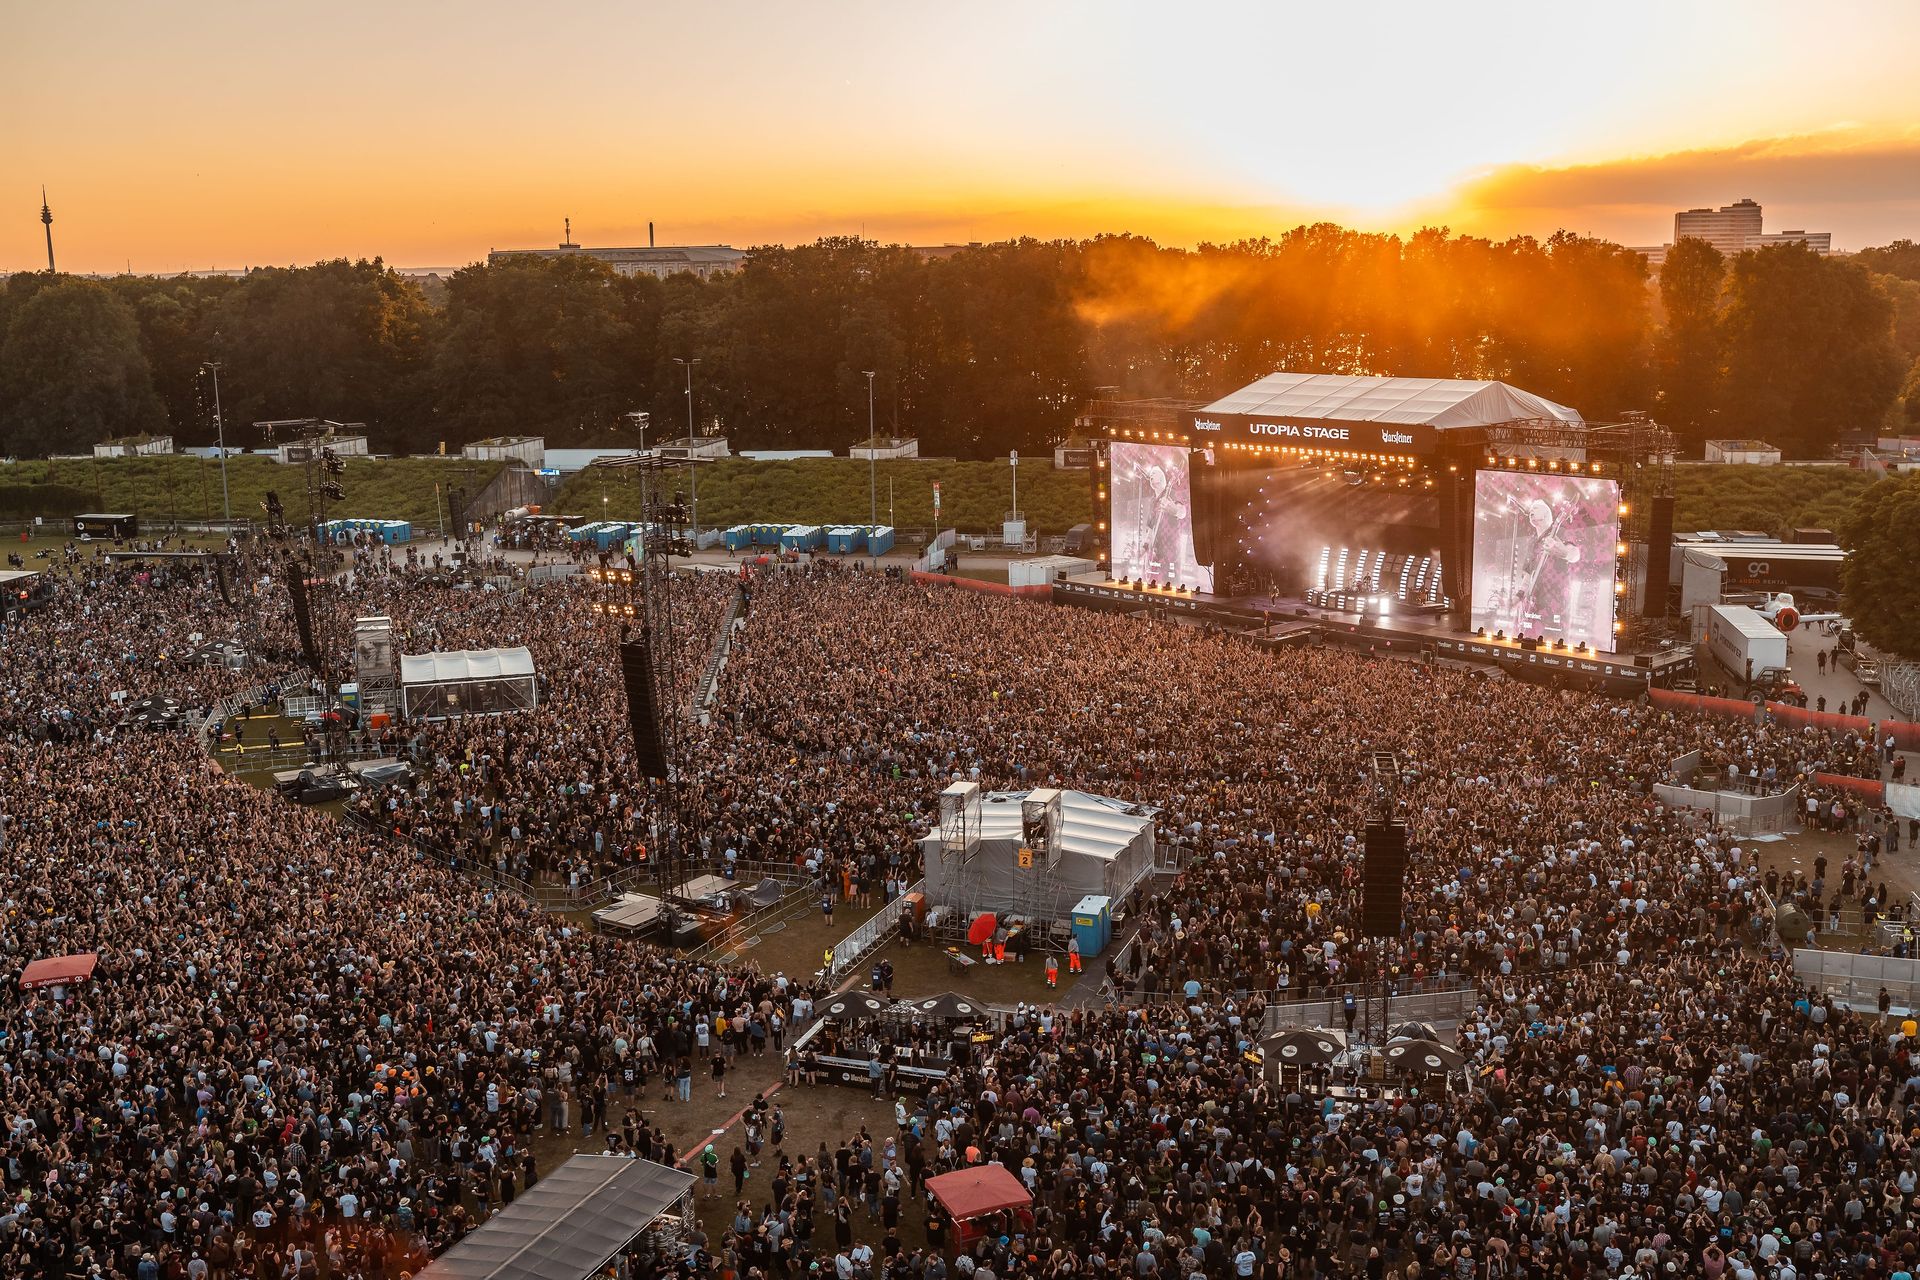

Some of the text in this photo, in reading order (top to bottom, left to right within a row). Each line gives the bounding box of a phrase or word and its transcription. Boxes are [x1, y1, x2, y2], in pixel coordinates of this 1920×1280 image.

[1250, 424, 1349, 440] UTOPIA STAGE
[1382, 429, 1412, 444] Warsteiner
[1022, 856, 1028, 865] 2
